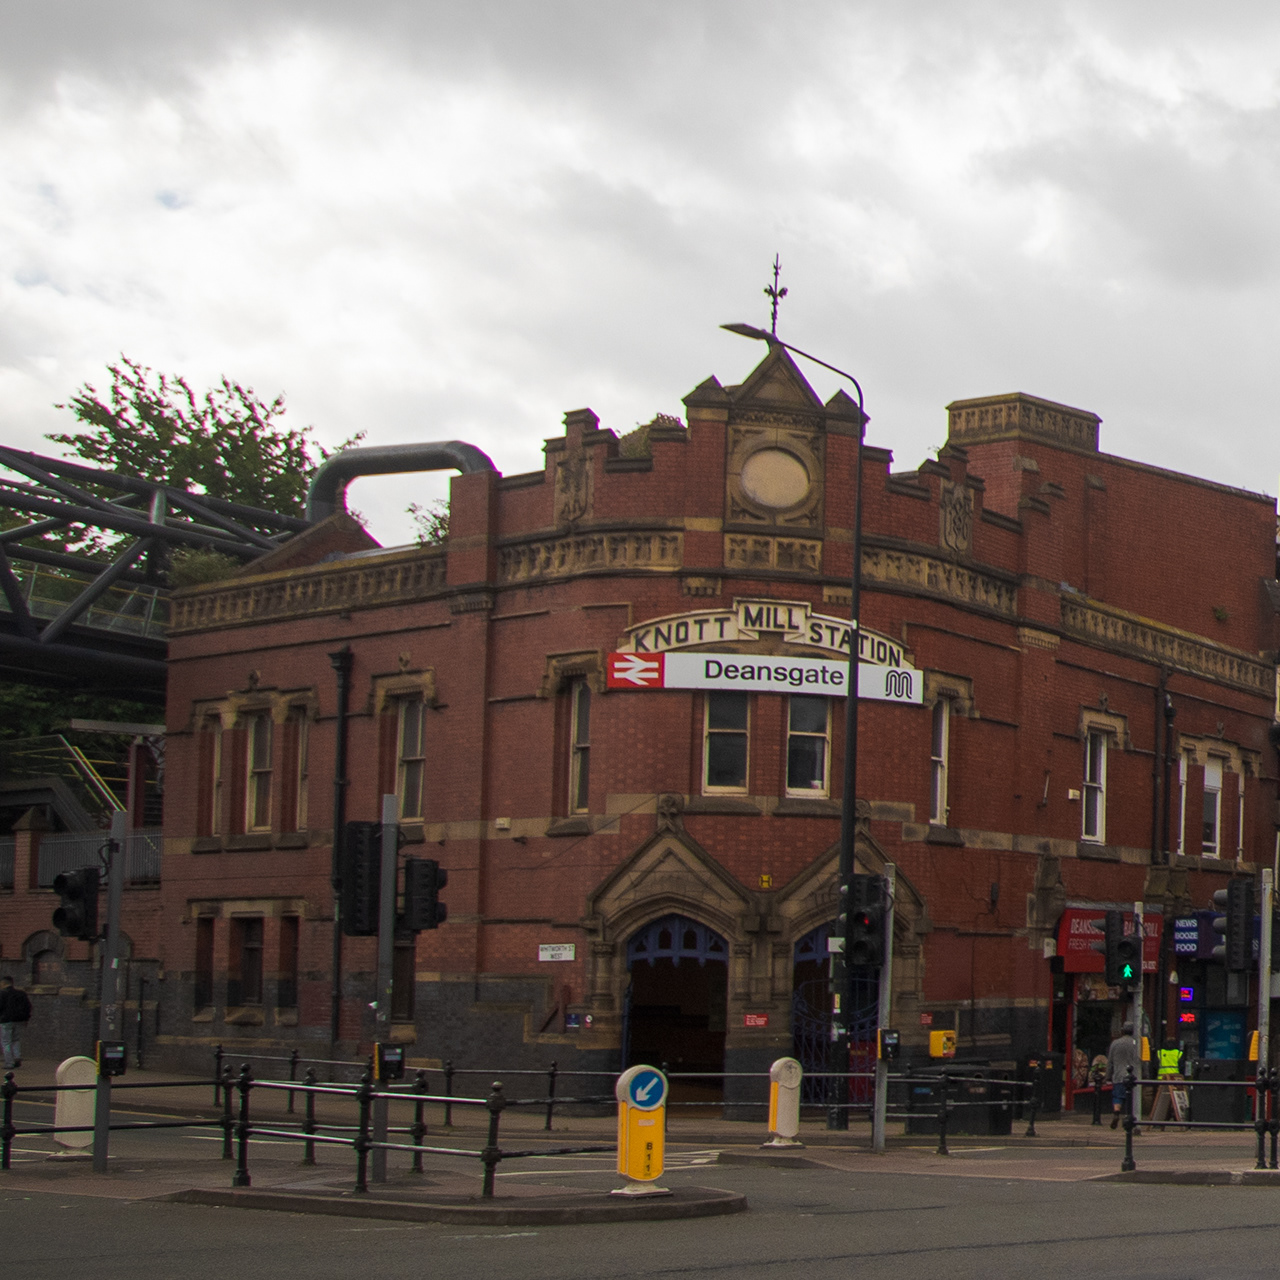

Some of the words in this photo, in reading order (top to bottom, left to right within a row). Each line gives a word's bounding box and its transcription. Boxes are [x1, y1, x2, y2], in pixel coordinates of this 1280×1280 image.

[634, 617, 731, 652] KNOTT
[744, 606, 800, 630] MILL
[810, 622, 901, 668] STATION
[705, 660, 844, 686] Deansgate
[1175, 919, 1198, 928] NEWS
[1174, 932, 1198, 940] BOOZE
[1175, 943, 1197, 952] FOOD
